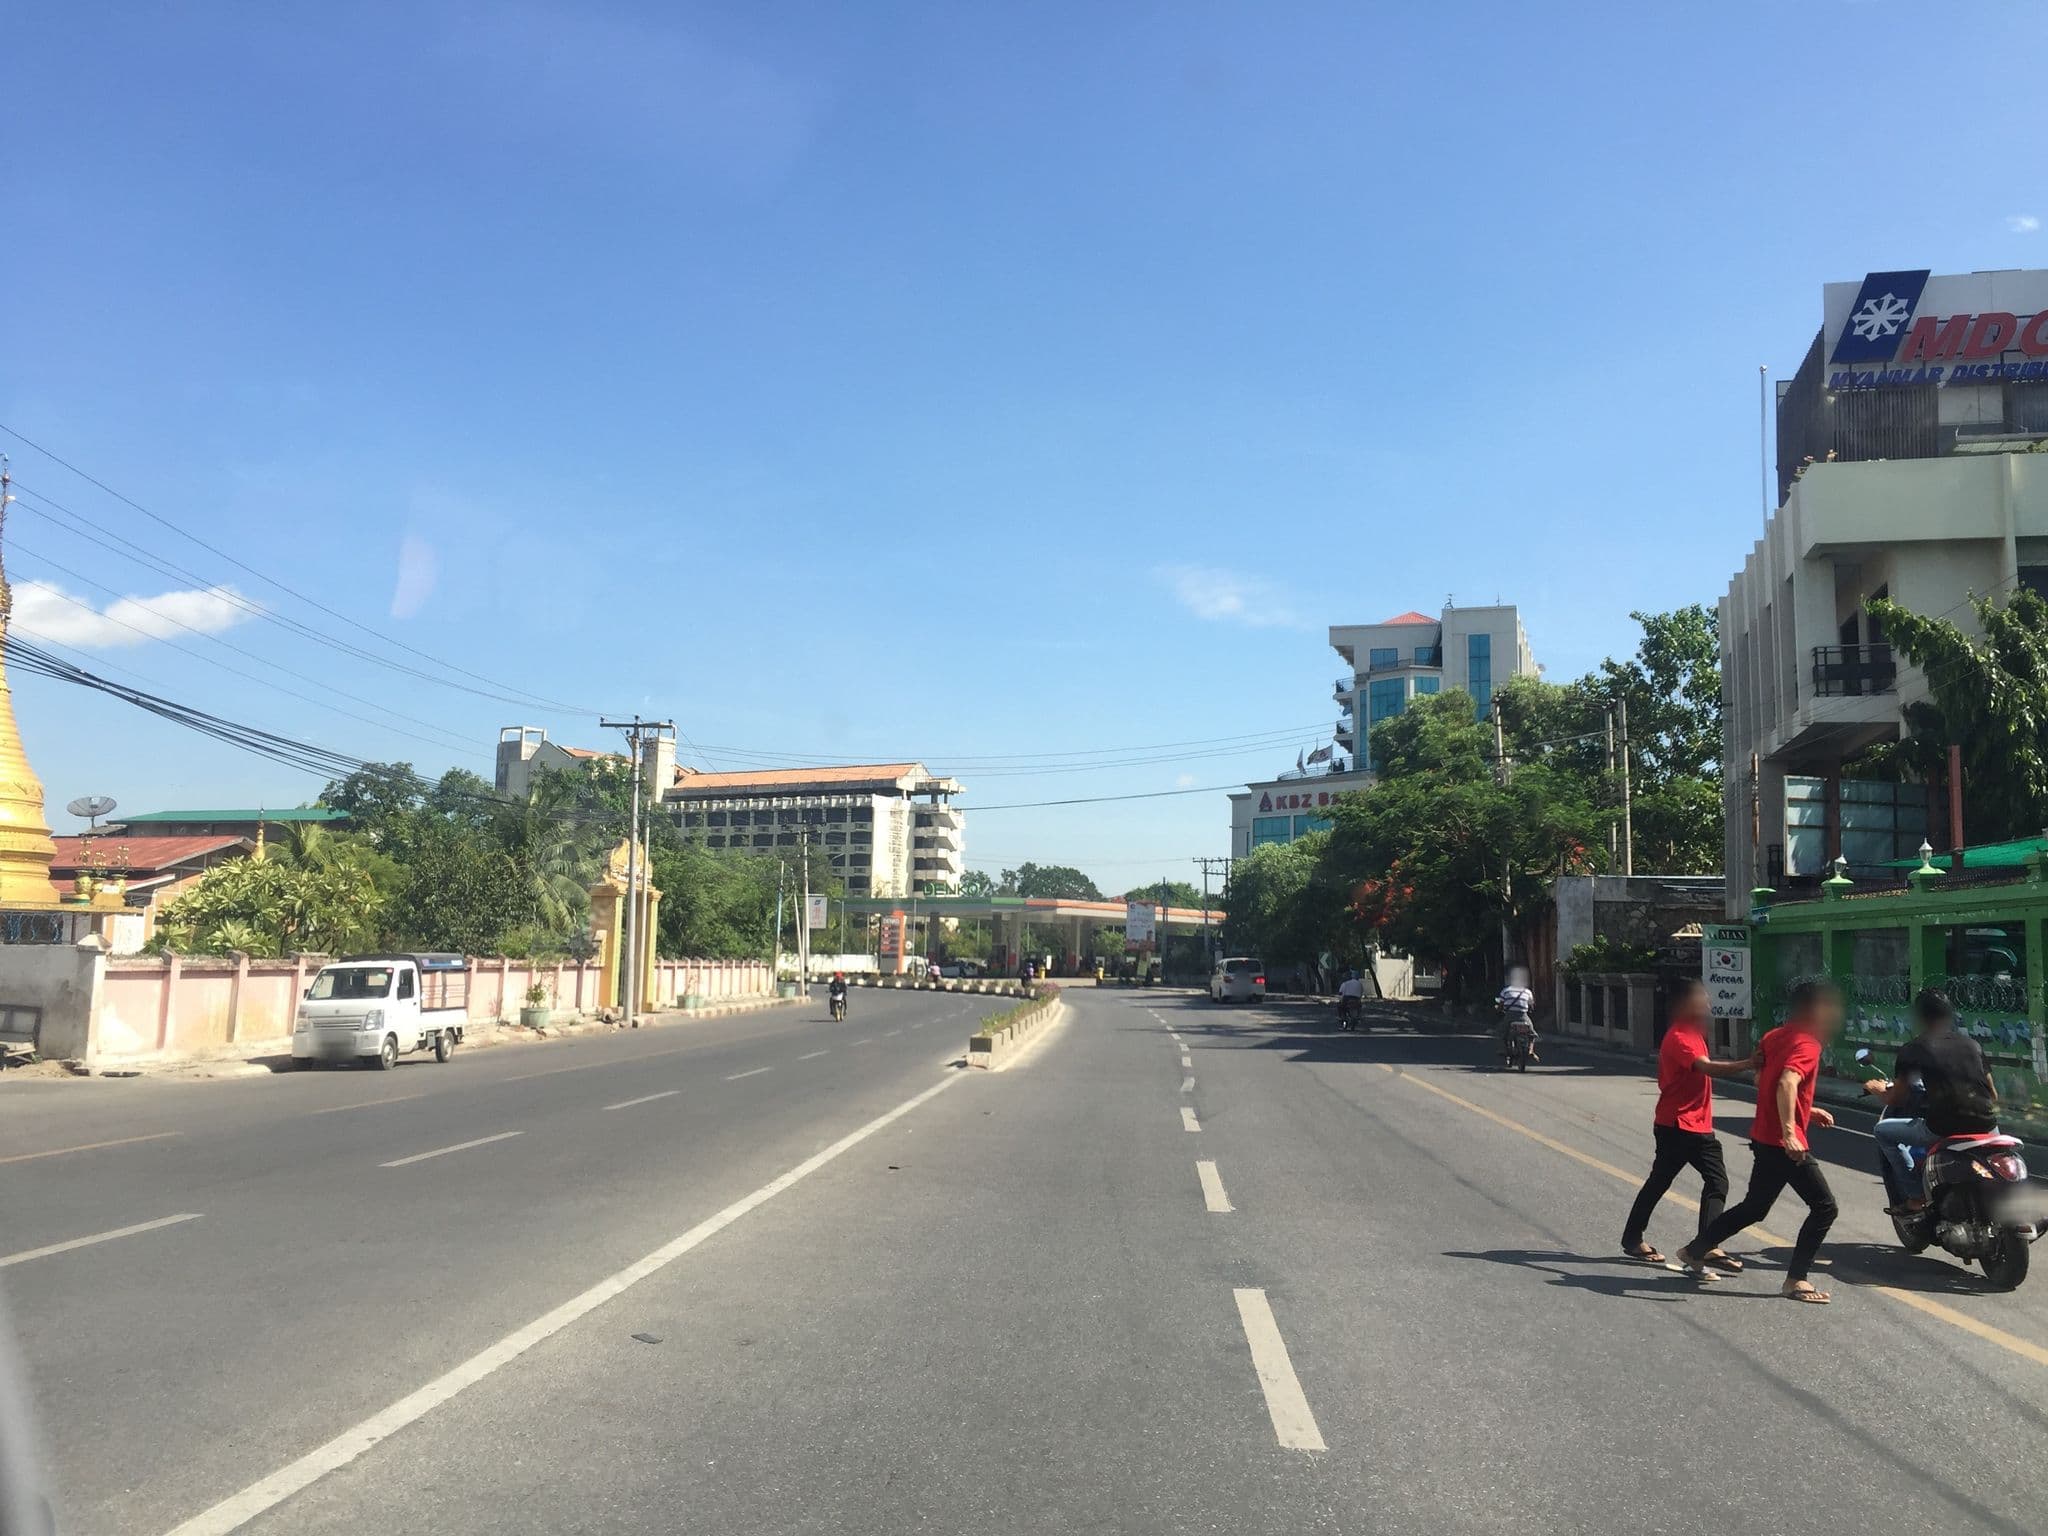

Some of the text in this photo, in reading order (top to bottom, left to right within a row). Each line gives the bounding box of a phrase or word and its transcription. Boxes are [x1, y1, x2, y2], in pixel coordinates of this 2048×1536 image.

[1828, 361, 2048, 389] MYANMAR DISTRIB
[1276, 793, 1312, 810] KBZ
[923, 881, 980, 897] DENKO
[1710, 973, 1744, 985] Korean
[1718, 989, 1737, 1000] Car
